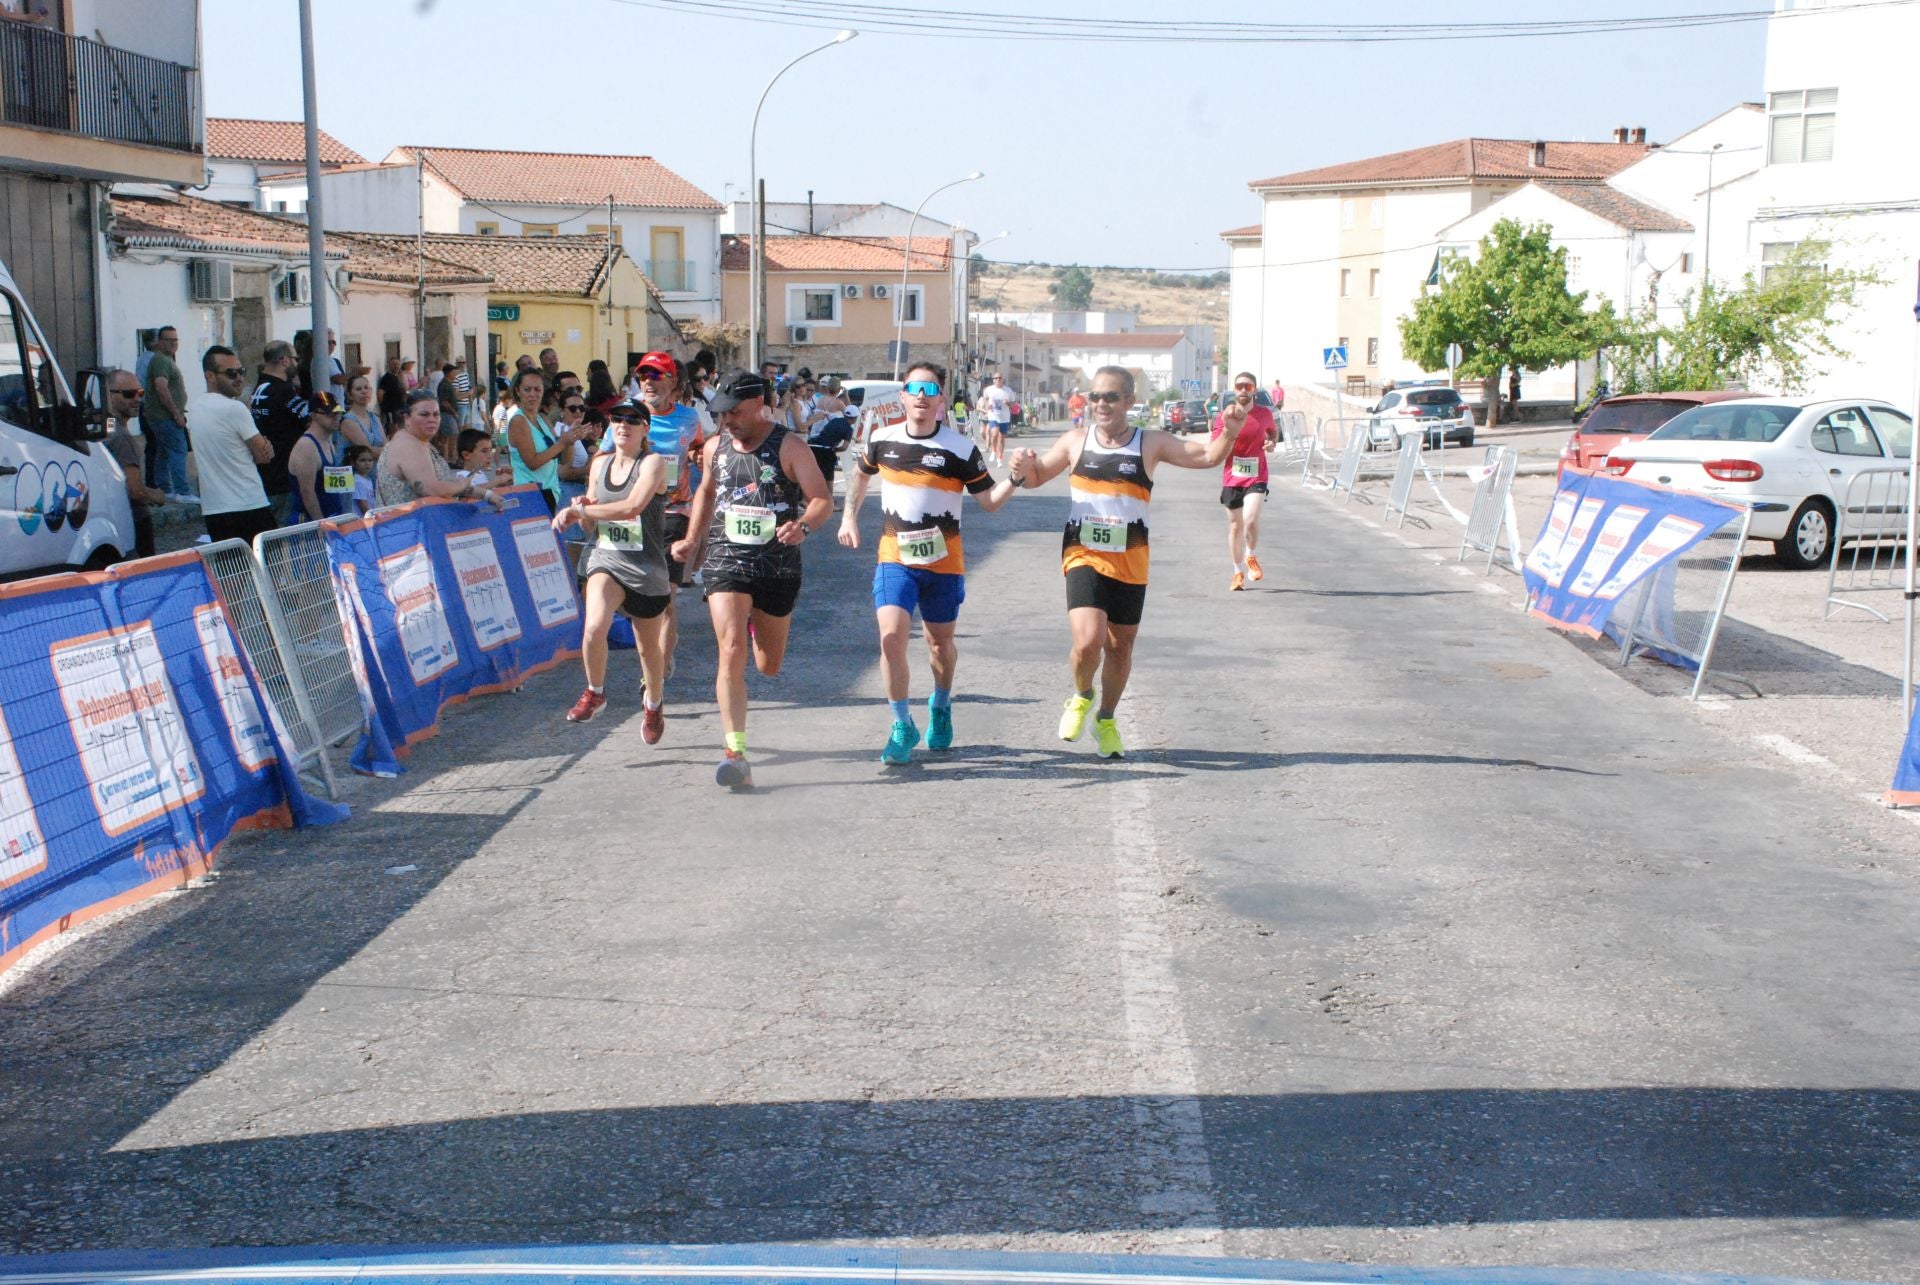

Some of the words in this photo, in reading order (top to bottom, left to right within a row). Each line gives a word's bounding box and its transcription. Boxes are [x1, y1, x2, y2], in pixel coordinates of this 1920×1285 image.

[607, 527, 629, 542] 194
[736, 520, 761, 536] 135
[1092, 528, 1111, 543] 55
[910, 541, 934, 557] 207
